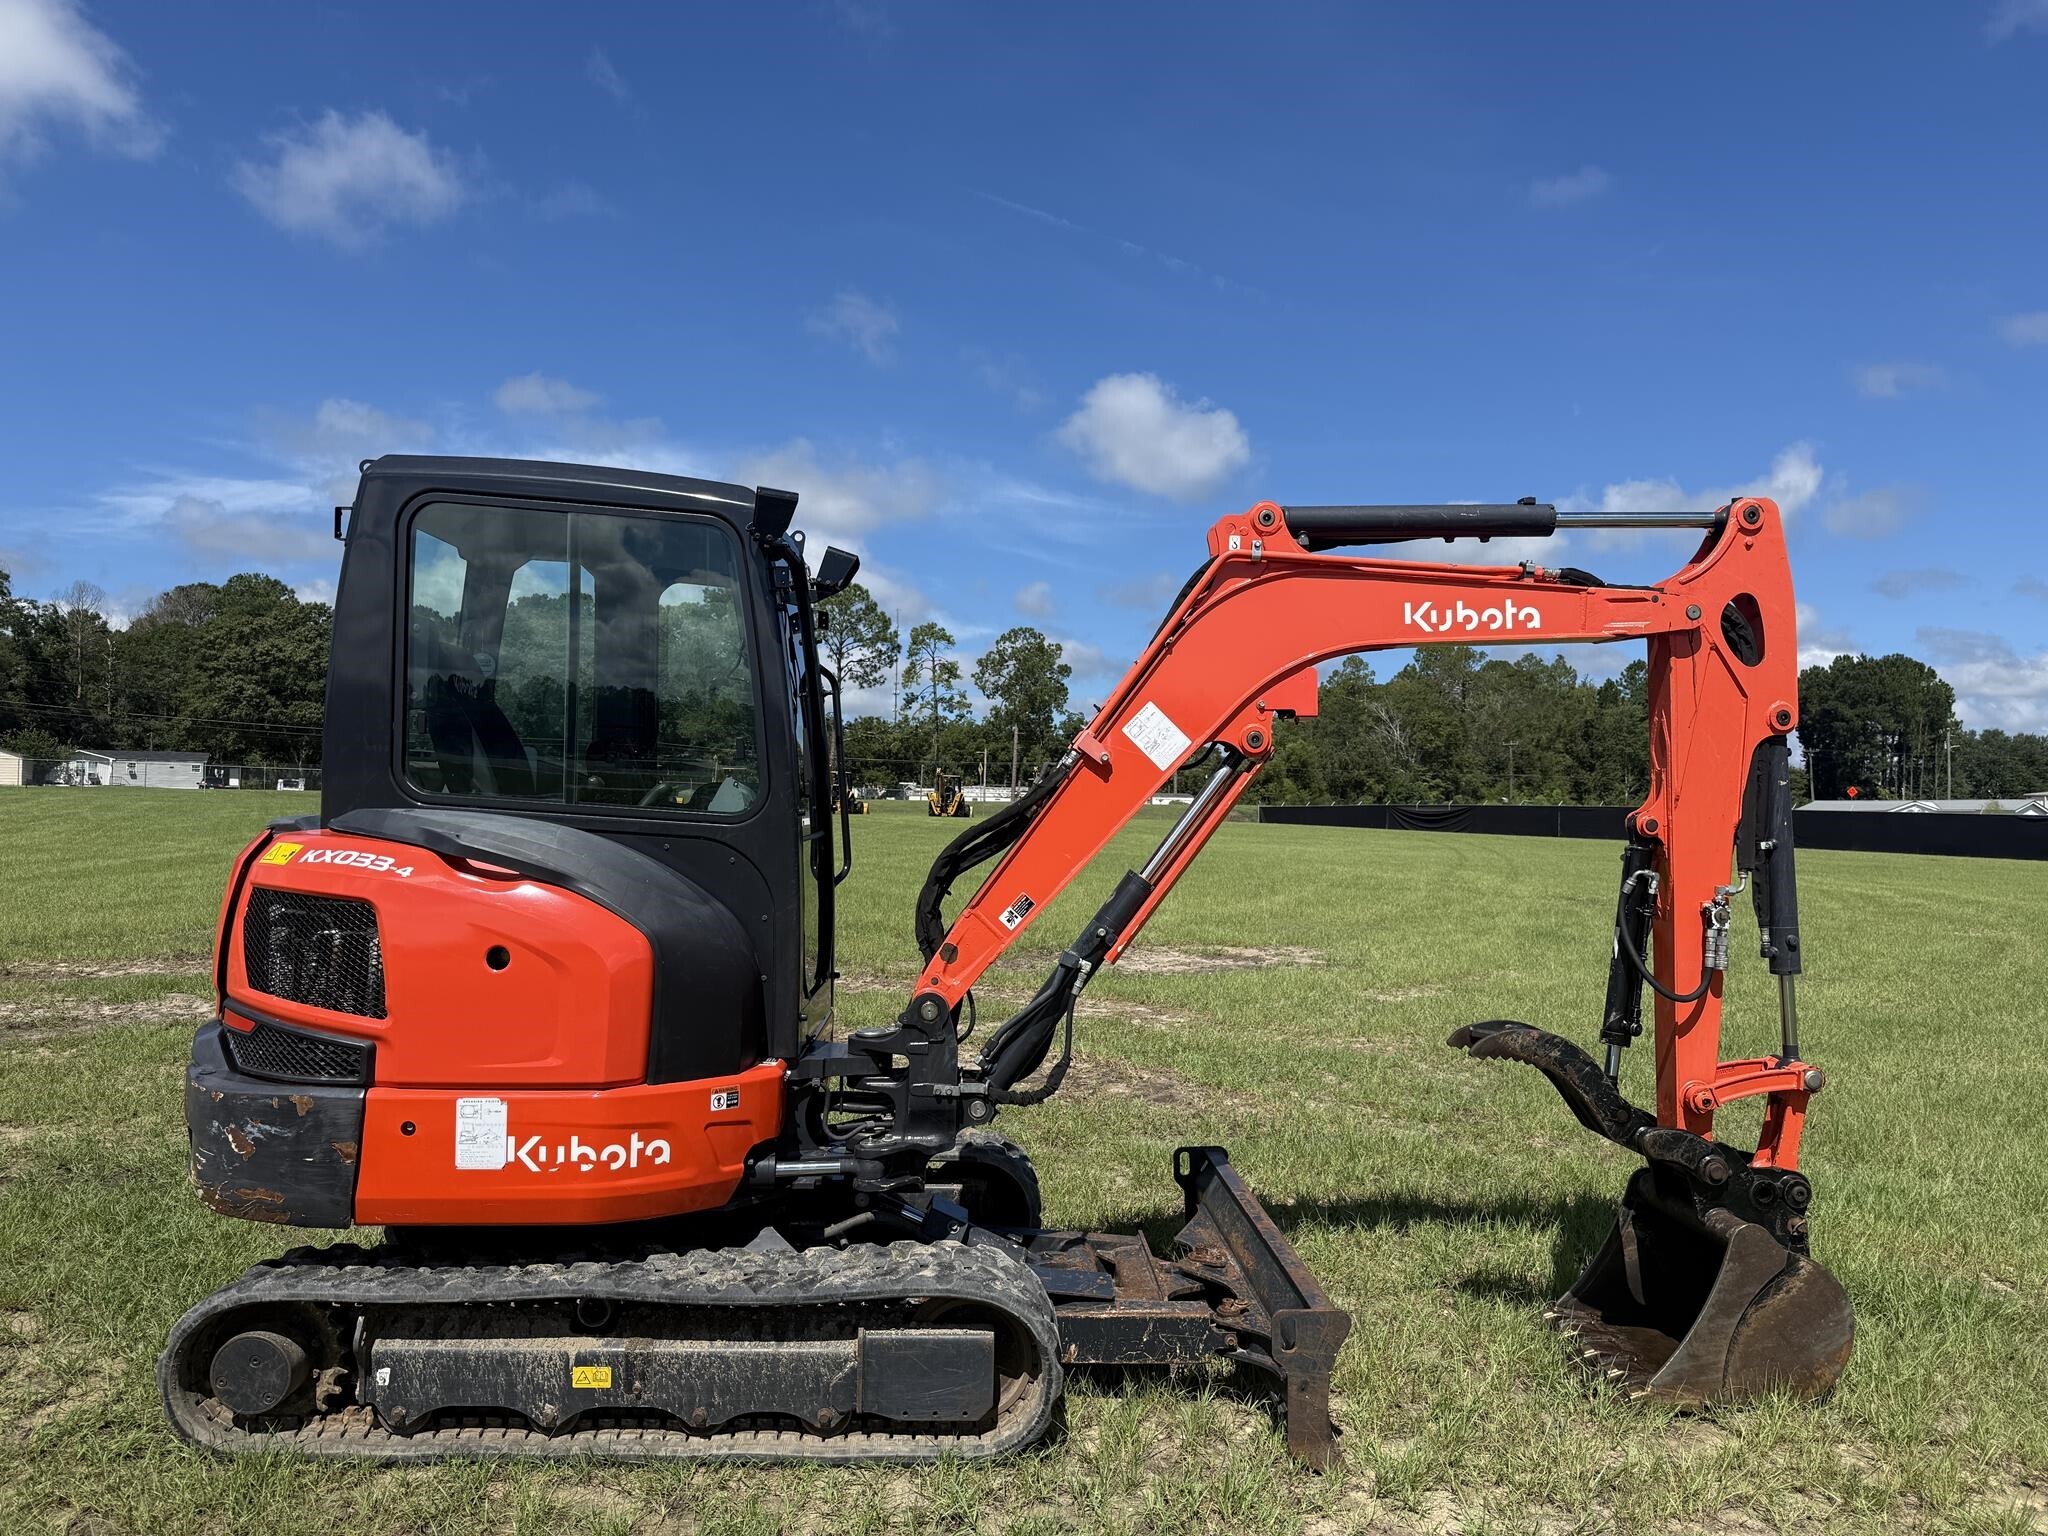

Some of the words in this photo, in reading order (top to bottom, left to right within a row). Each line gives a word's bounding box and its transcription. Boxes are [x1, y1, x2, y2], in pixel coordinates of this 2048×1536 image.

[1404, 599, 1541, 632] Kubota
[298, 849, 414, 878] KX033-4
[507, 1132, 671, 1172] Kubota
